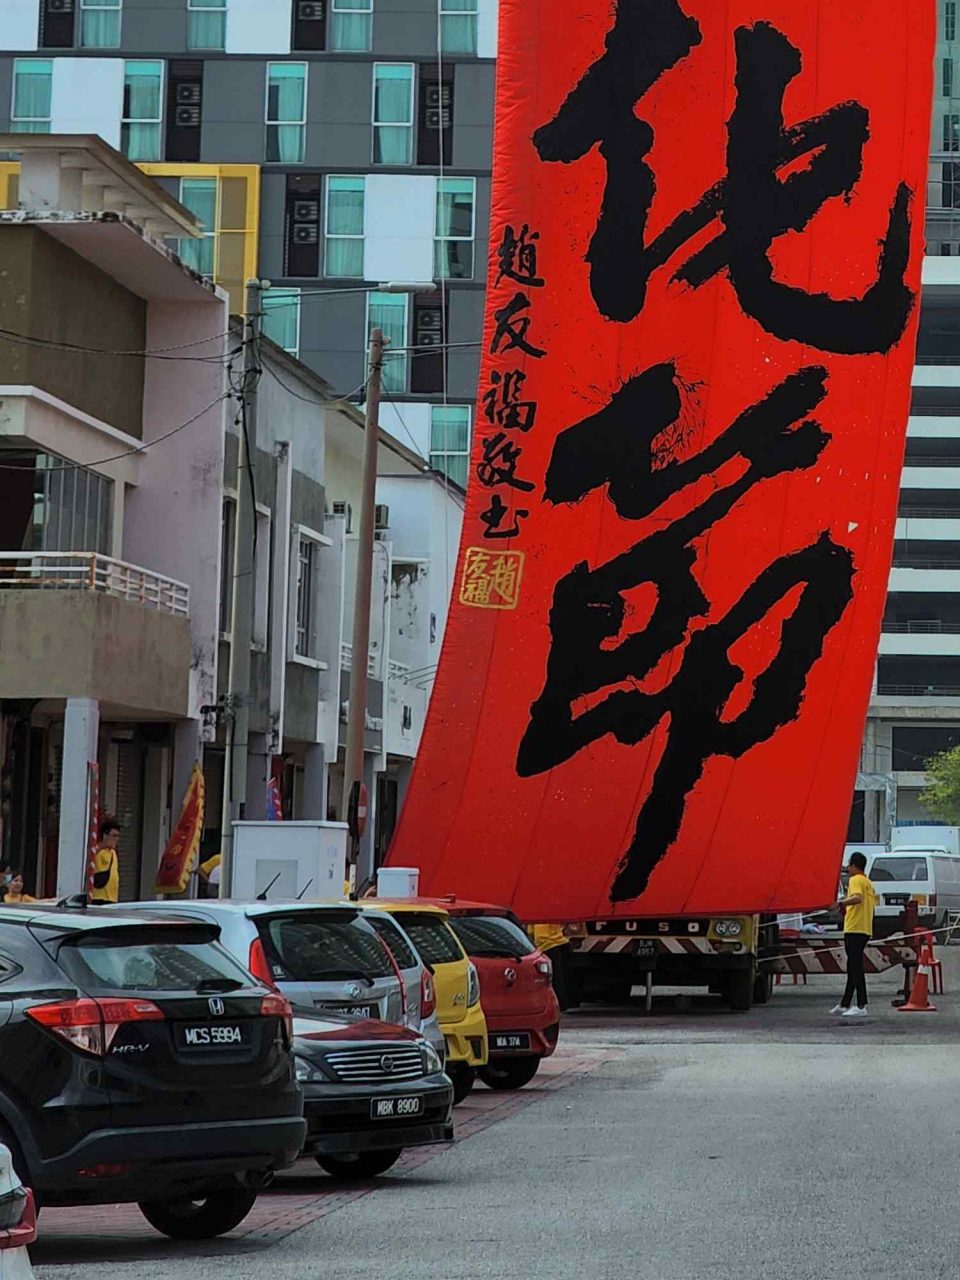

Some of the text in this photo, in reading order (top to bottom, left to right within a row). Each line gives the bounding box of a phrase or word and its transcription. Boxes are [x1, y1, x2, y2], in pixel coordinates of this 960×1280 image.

[595, 921, 700, 933] FUSO
[185, 1026, 242, 1045] MCS 5994
[112, 1043, 150, 1054] HR-V
[377, 1098, 420, 1116] MBK 8900
